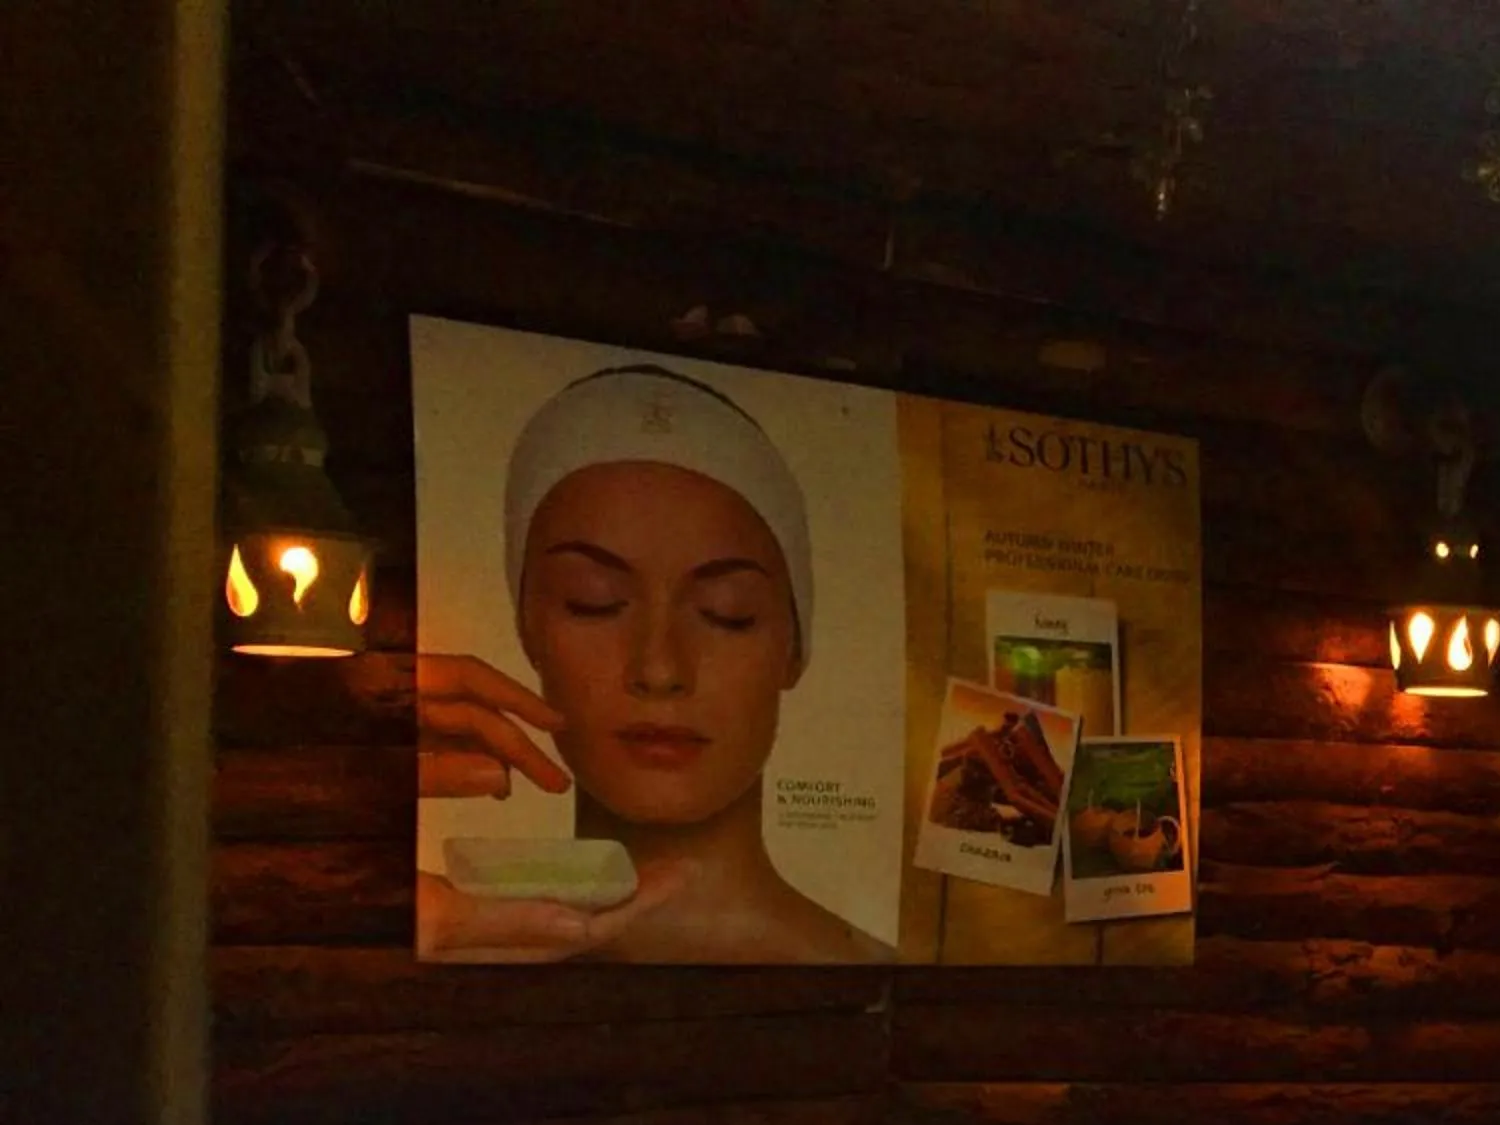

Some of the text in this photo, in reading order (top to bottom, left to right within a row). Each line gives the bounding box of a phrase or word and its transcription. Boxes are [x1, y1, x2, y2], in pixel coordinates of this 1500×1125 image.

[1008, 426, 1188, 487] SOTHYS
[776, 779, 841, 793] COMFORT
[791, 793, 877, 808] NOURISHING
